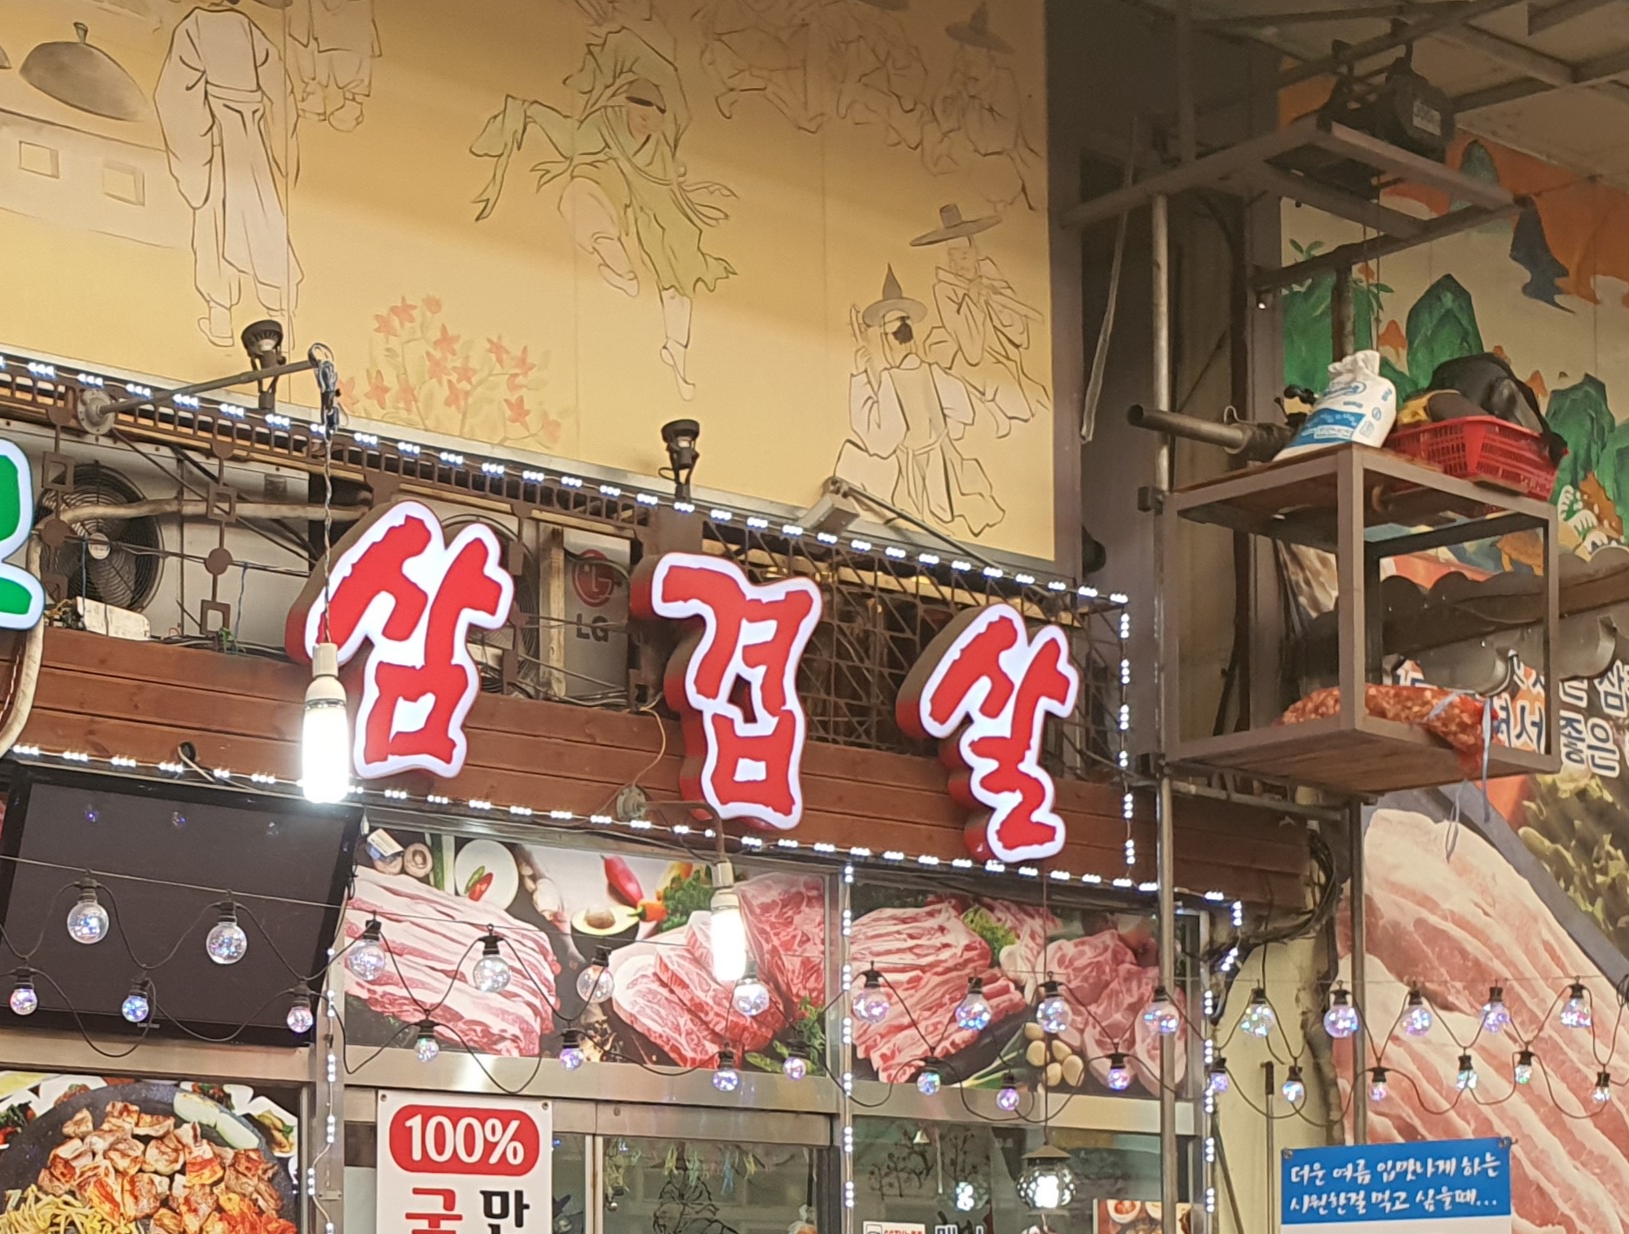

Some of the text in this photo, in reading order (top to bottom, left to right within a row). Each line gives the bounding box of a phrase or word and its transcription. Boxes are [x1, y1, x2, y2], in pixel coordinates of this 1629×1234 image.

[576, 613, 609, 643] LG
[305, 500, 1079, 862] 삼겹살
[404, 1113, 525, 1166] 100%
[1290, 1152, 1501, 1186] 더운 여름 입맛나게 하는
[1371, 1190, 1410, 1213] 먹고
